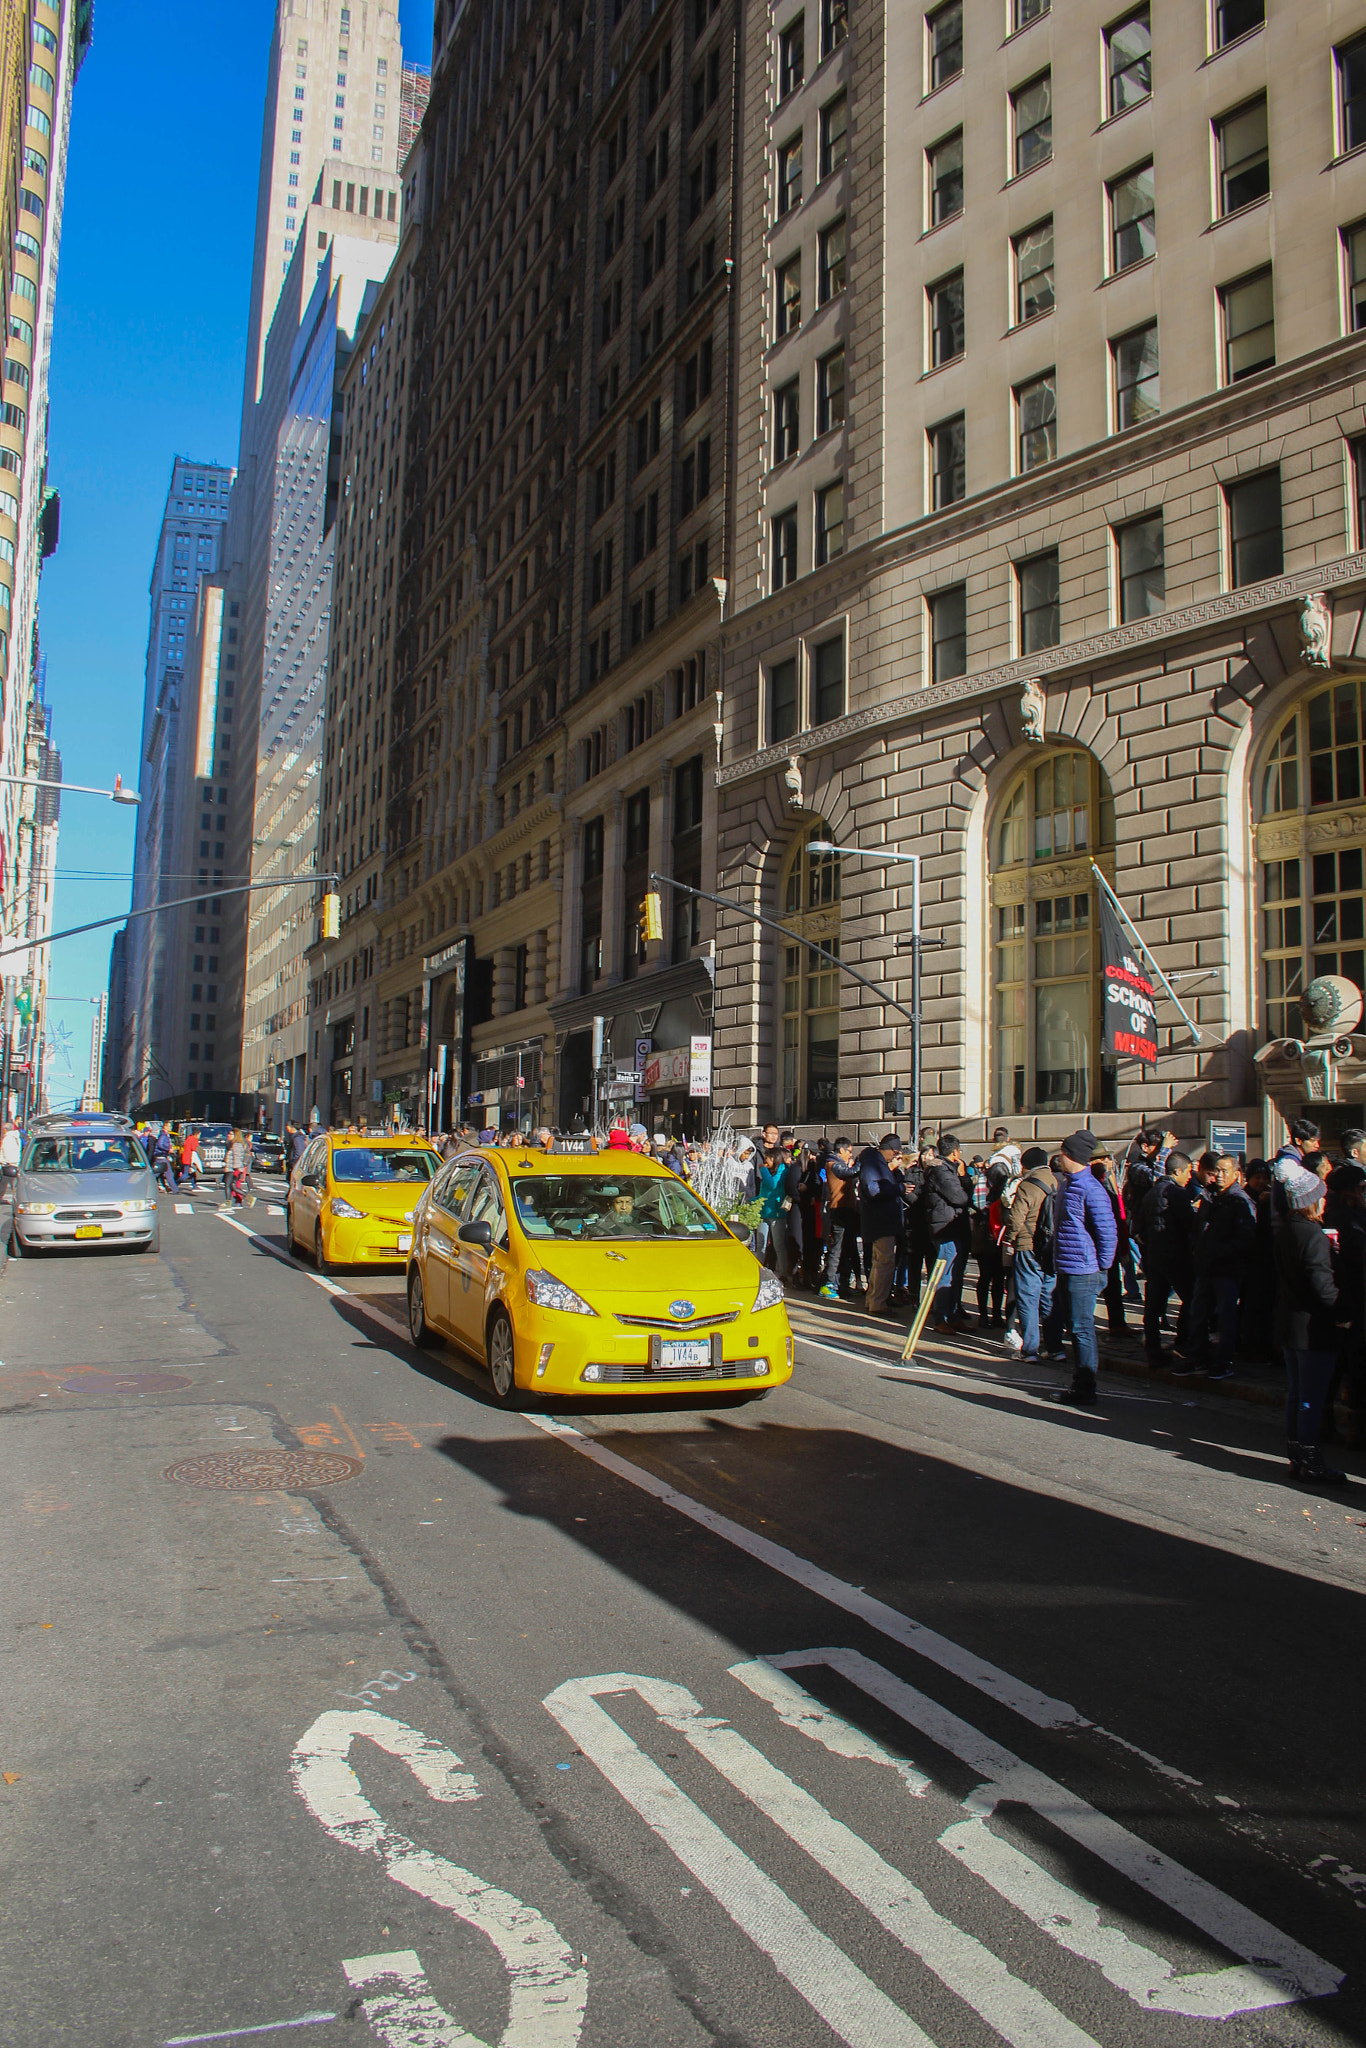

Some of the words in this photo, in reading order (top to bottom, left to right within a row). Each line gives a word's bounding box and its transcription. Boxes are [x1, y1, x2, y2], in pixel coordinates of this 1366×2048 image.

[1122, 956, 1139, 977] the
[1130, 1012, 1148, 1034] OF
[1114, 1030, 1157, 1063] MUSIC
[561, 1140, 584, 1152] 1V44
